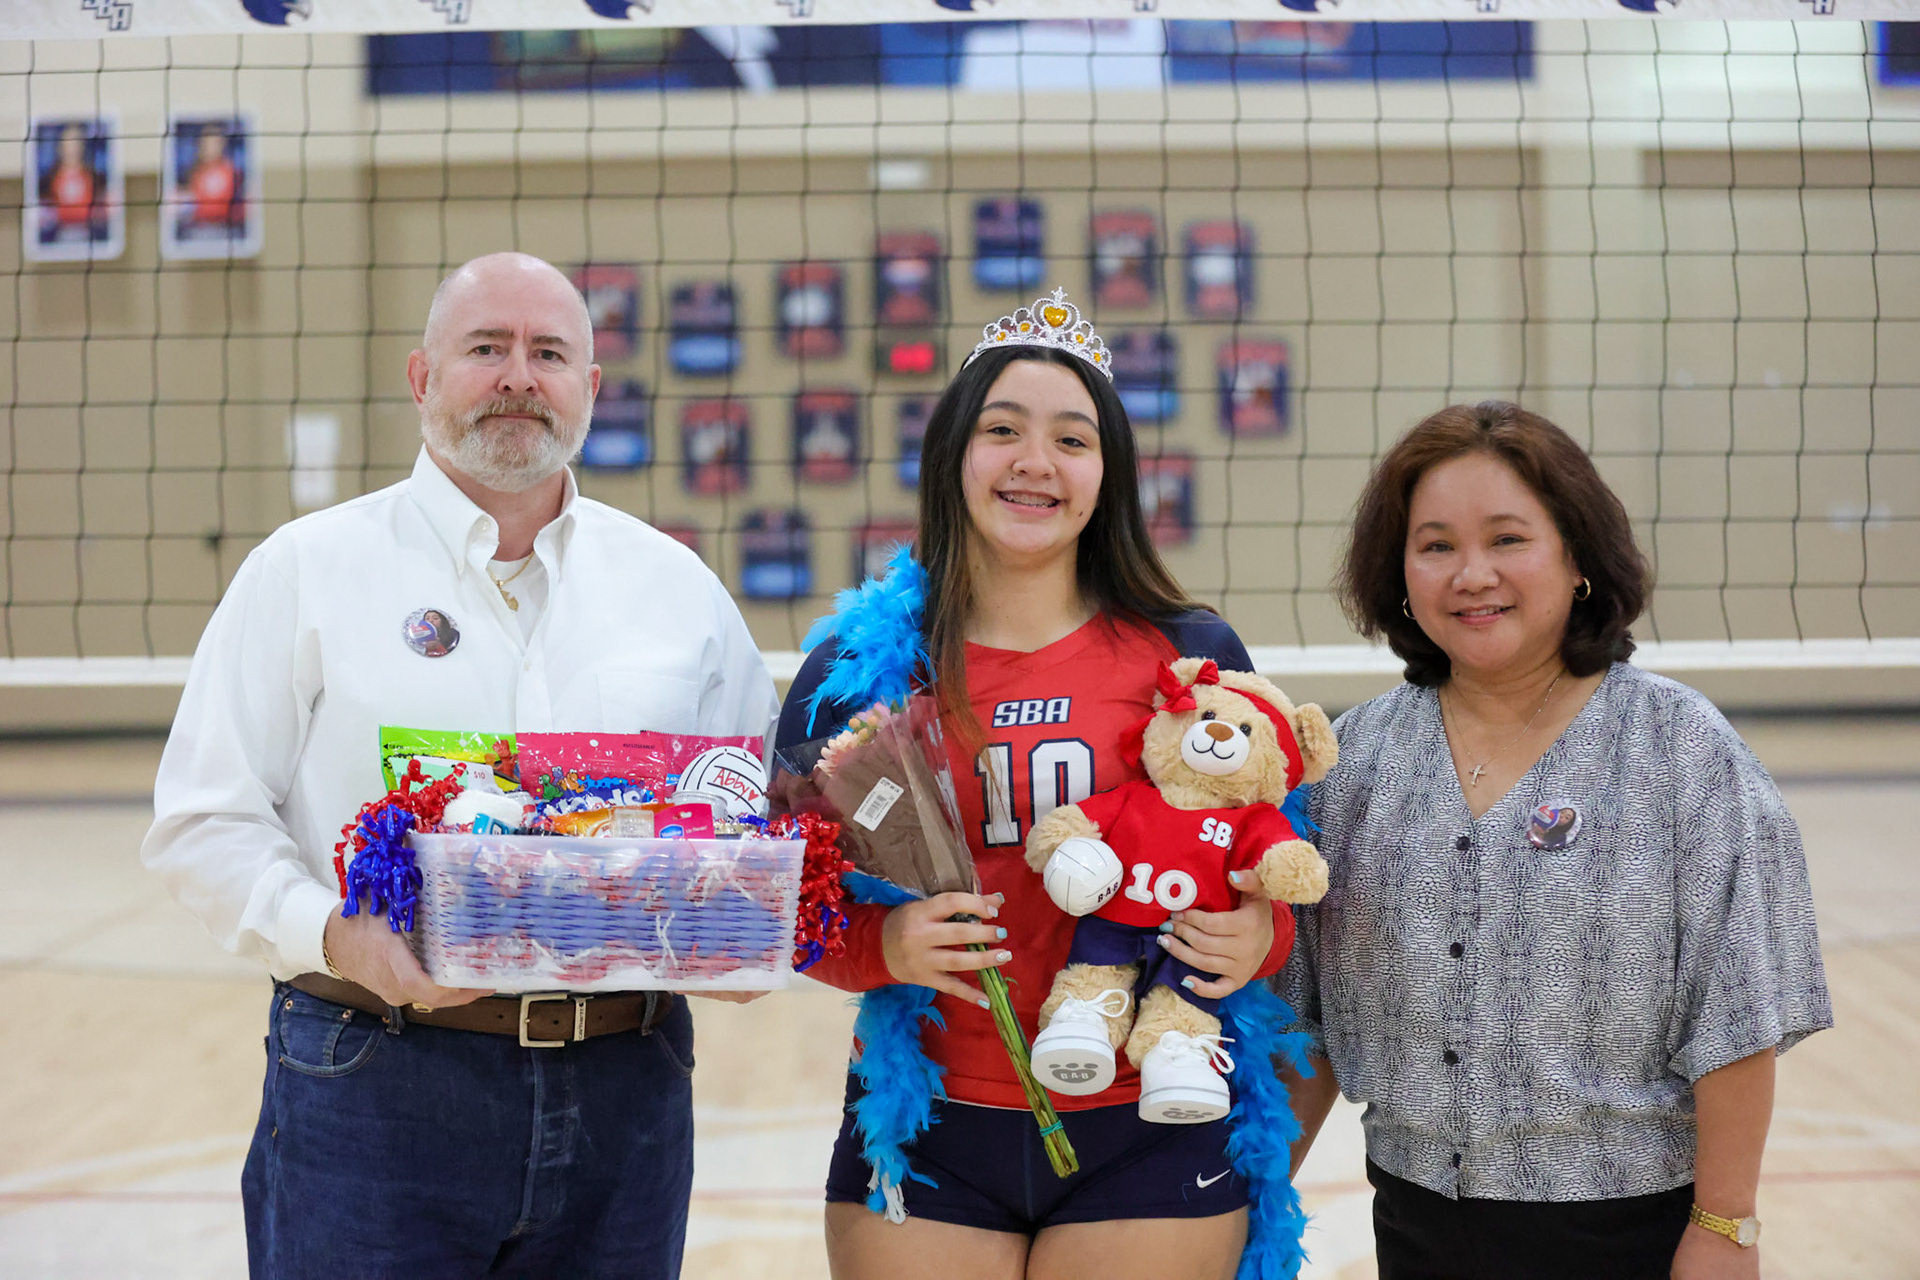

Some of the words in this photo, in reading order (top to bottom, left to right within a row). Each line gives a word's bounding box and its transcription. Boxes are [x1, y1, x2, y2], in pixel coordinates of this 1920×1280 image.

[992, 696, 1072, 728] SBA
[473, 771, 486, 780] $10
[713, 768, 750, 801] Abby
[974, 737, 1096, 848] 10
[1198, 817, 1236, 849] SB
[1124, 862, 1198, 911] 10
